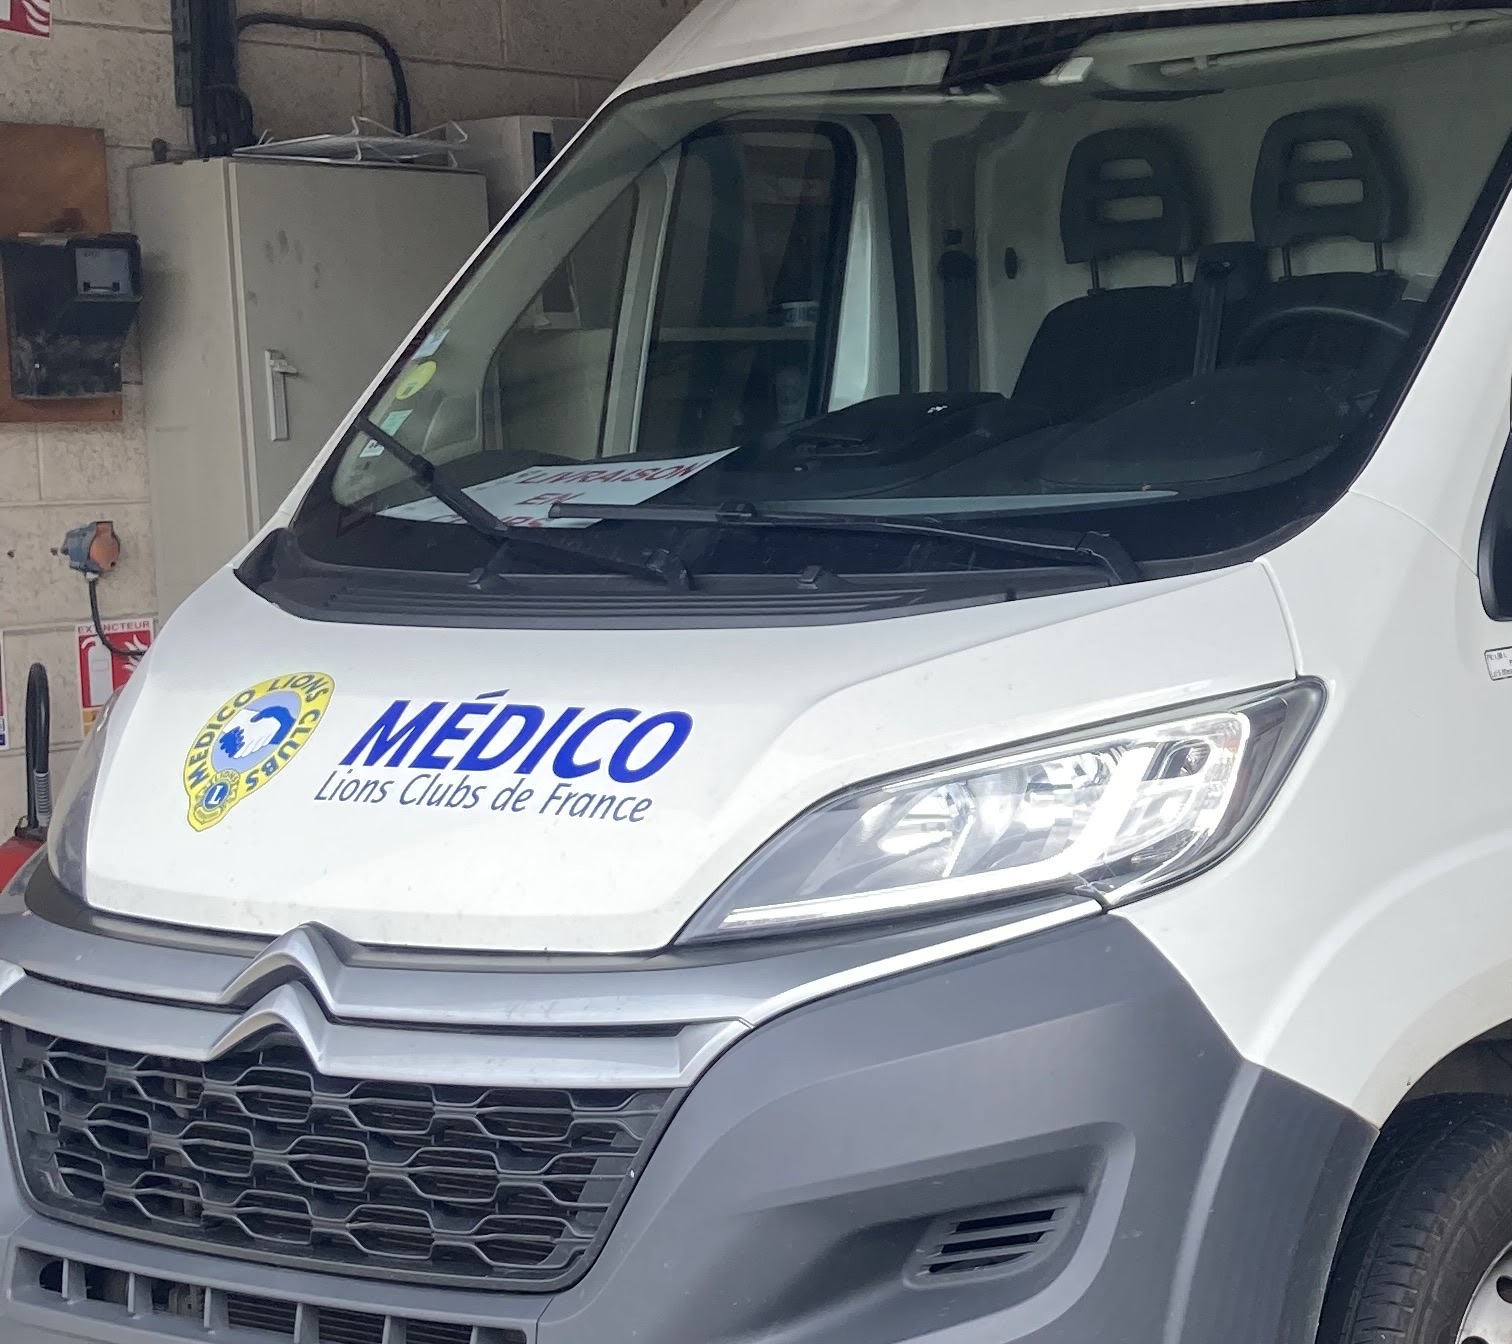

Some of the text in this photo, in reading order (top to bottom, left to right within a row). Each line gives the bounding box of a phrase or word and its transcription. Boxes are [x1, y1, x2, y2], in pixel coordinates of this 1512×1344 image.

[520, 463, 702, 484] LIVRAISON
[77, 620, 150, 634] EXNCTEUR
[188, 674, 330, 793] MEDICO LIONS CLUBS
[339, 689, 693, 784] MÉDICO
[208, 785, 224, 805] L
[314, 768, 653, 824] Lions Clubs de France
